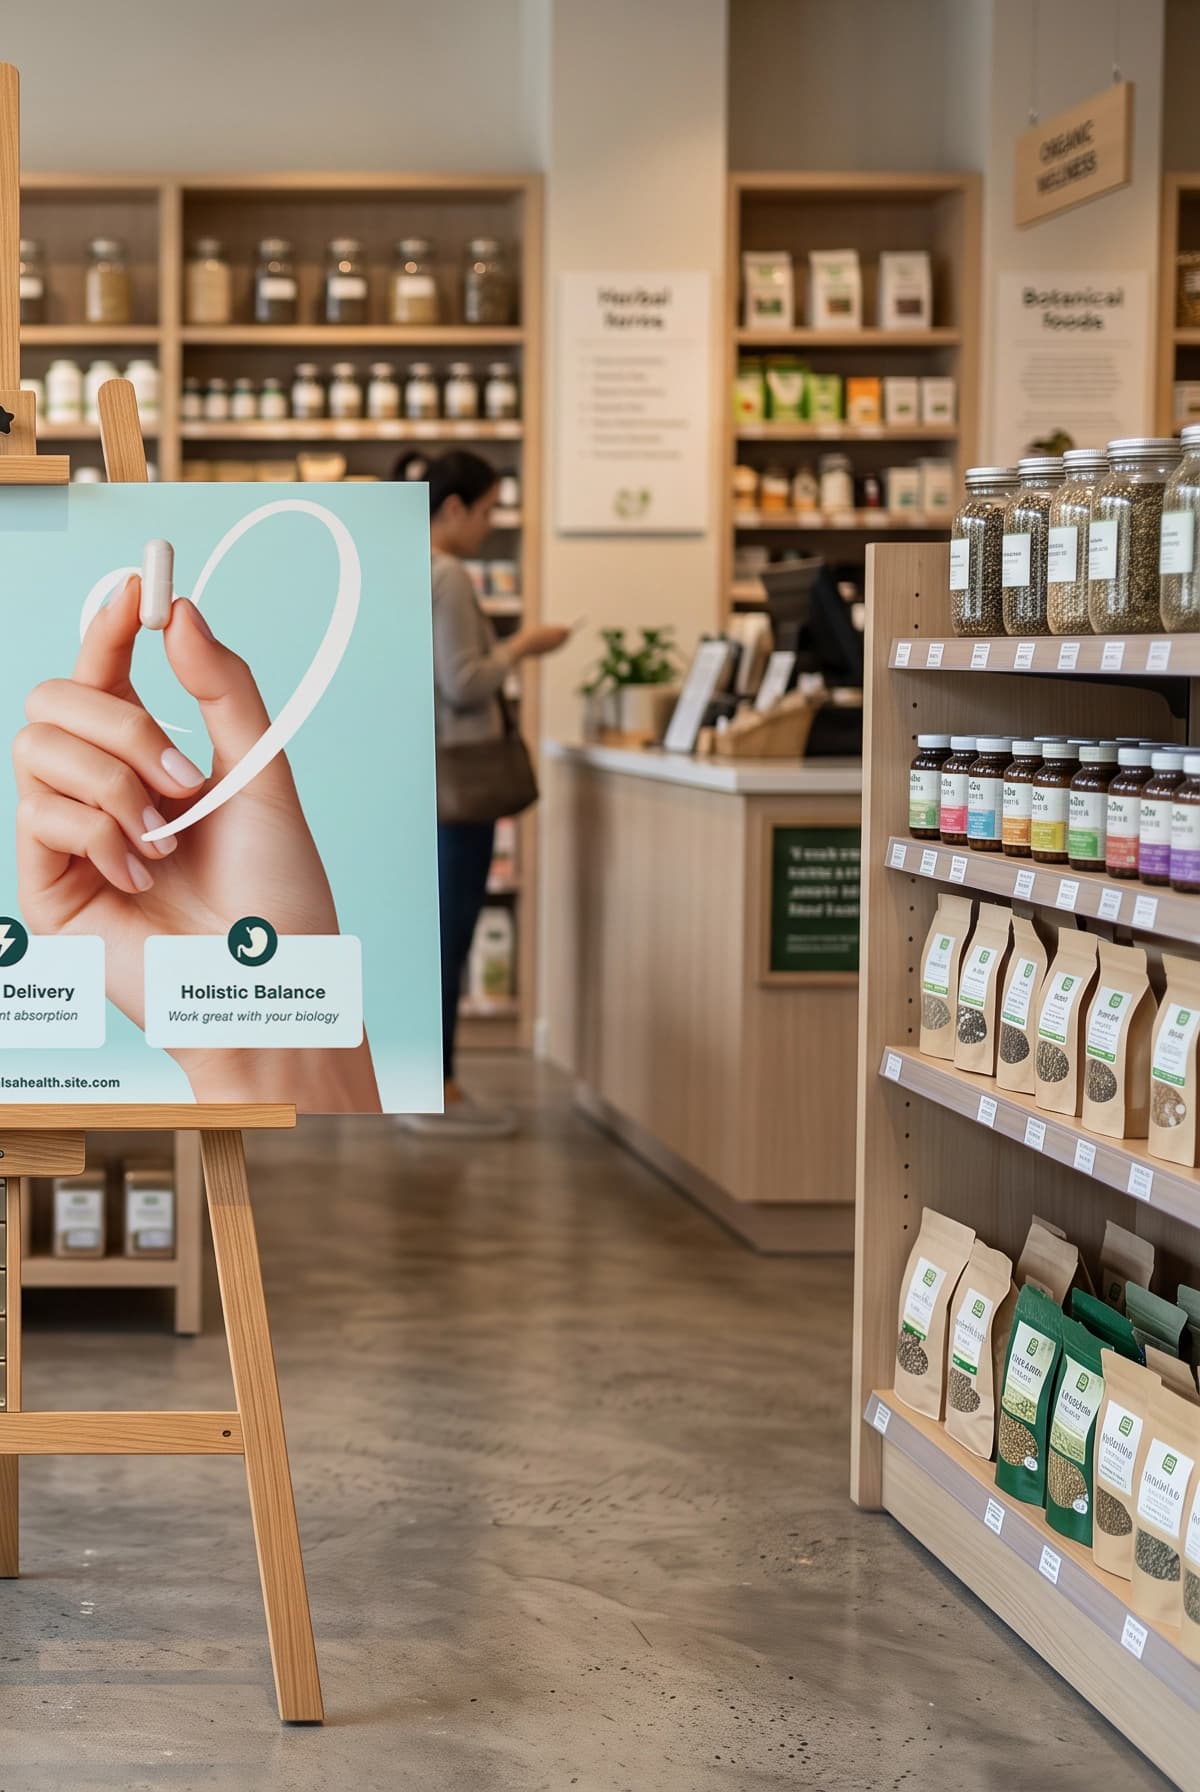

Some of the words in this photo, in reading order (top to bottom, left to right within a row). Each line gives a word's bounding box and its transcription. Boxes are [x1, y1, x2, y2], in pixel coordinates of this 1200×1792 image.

[1022, 286, 1124, 308] Botanical
[2, 983, 76, 1003] Delivery
[180, 984, 249, 1000] Holistic
[253, 984, 327, 1000] Balance
[13, 1009, 79, 1023] absorption
[168, 1010, 200, 1022] Work
[201, 1010, 234, 1025] great
[236, 1010, 262, 1022] with
[264, 1012, 293, 1025] your
[295, 1010, 340, 1025] biology
